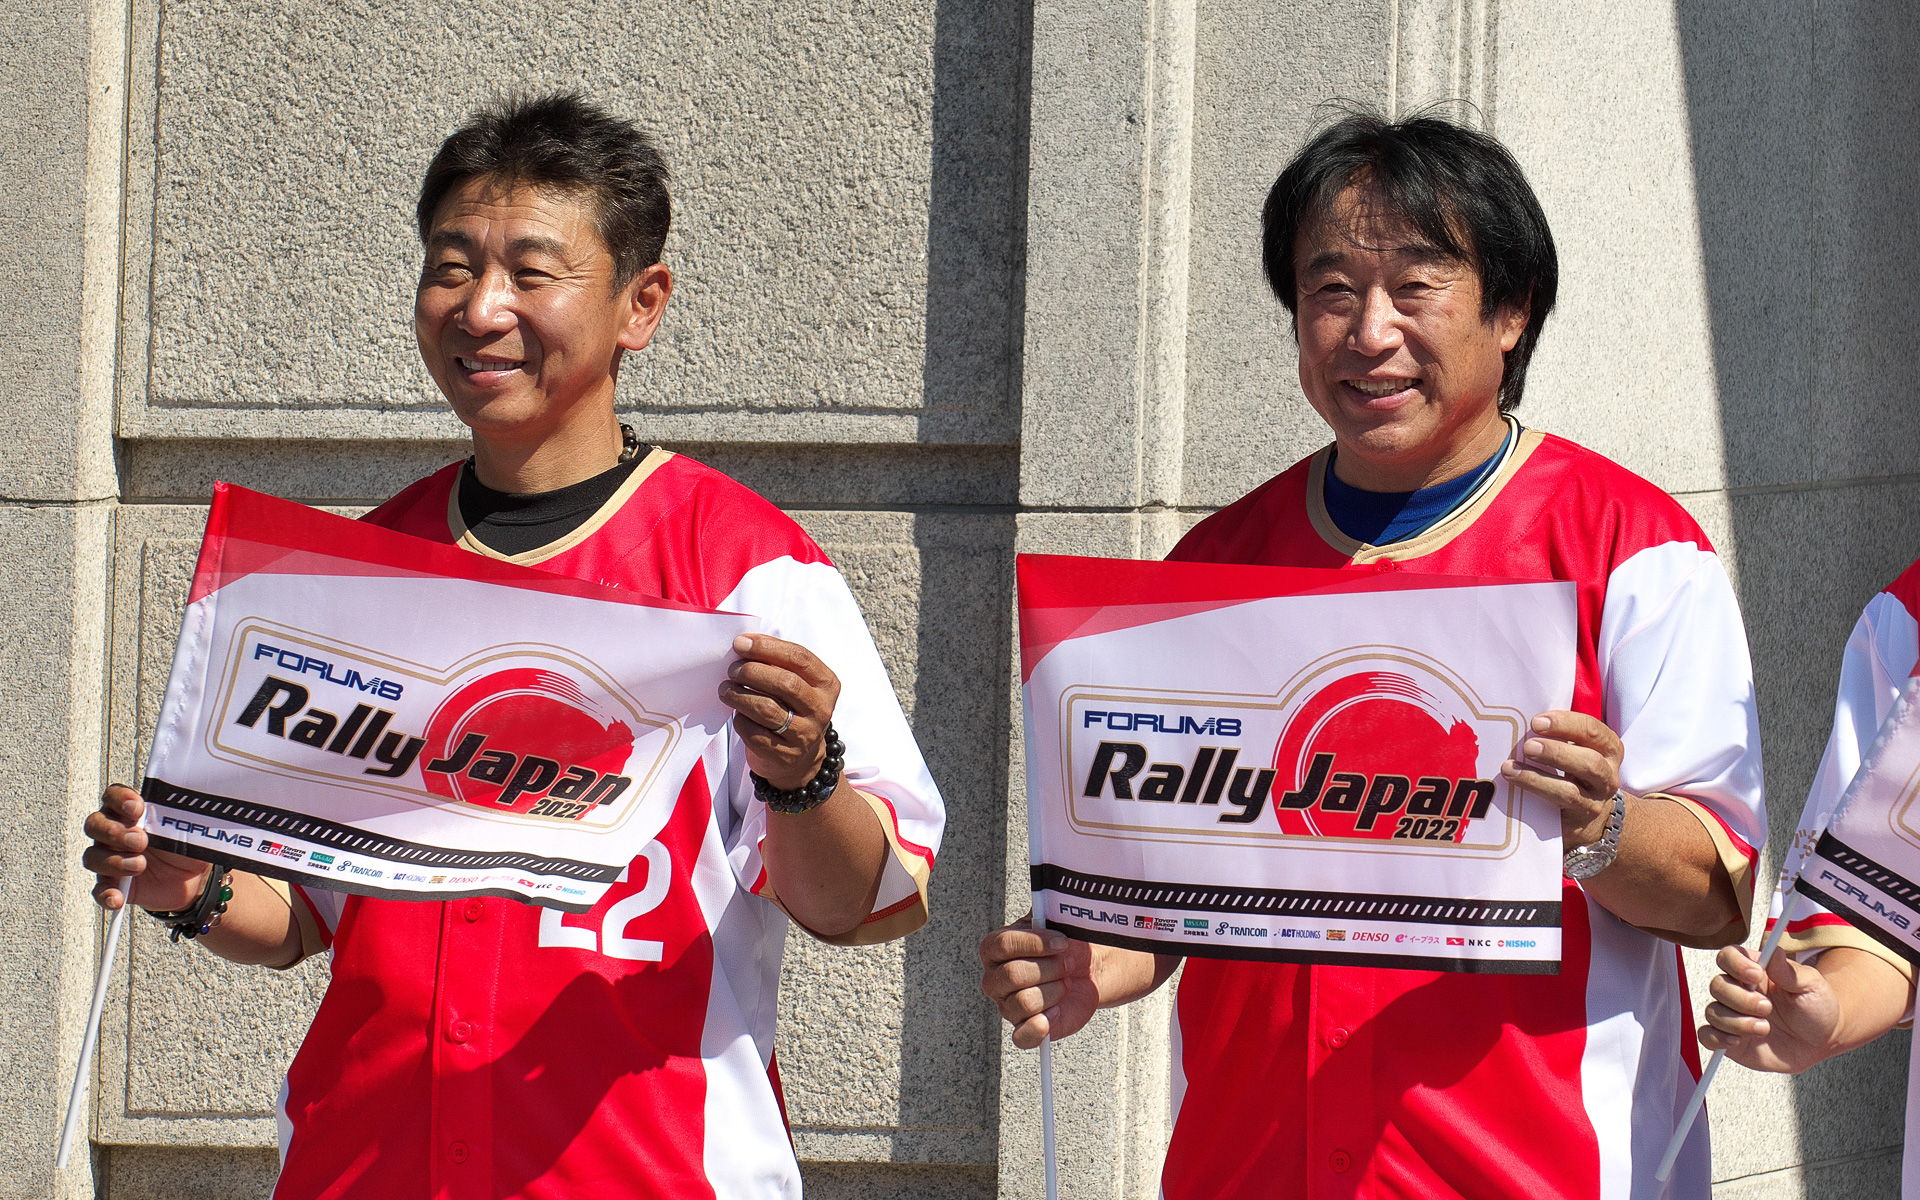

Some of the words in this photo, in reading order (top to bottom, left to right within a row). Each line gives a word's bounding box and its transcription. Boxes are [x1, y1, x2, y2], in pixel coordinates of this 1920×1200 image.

[254, 643, 404, 701] FORUM8
[1084, 709, 1242, 737] FORUM8
[234, 674, 428, 778] Rally
[426, 731, 634, 807] Japan
[1082, 741, 1277, 824] Rally
[1278, 752, 1497, 831] Japan
[528, 798, 591, 820] 2022
[161, 816, 255, 848] FORUM8
[1393, 818, 1460, 841] 2022
[258, 843, 281, 856] GR
[448, 876, 479, 884] DENSO
[1820, 870, 1911, 930] FORUM8
[1059, 903, 1129, 926] FORUM8
[1229, 926, 1268, 937] TRANCOM
[1352, 932, 1389, 942] DENSO
[1505, 940, 1536, 948] NISHIO
